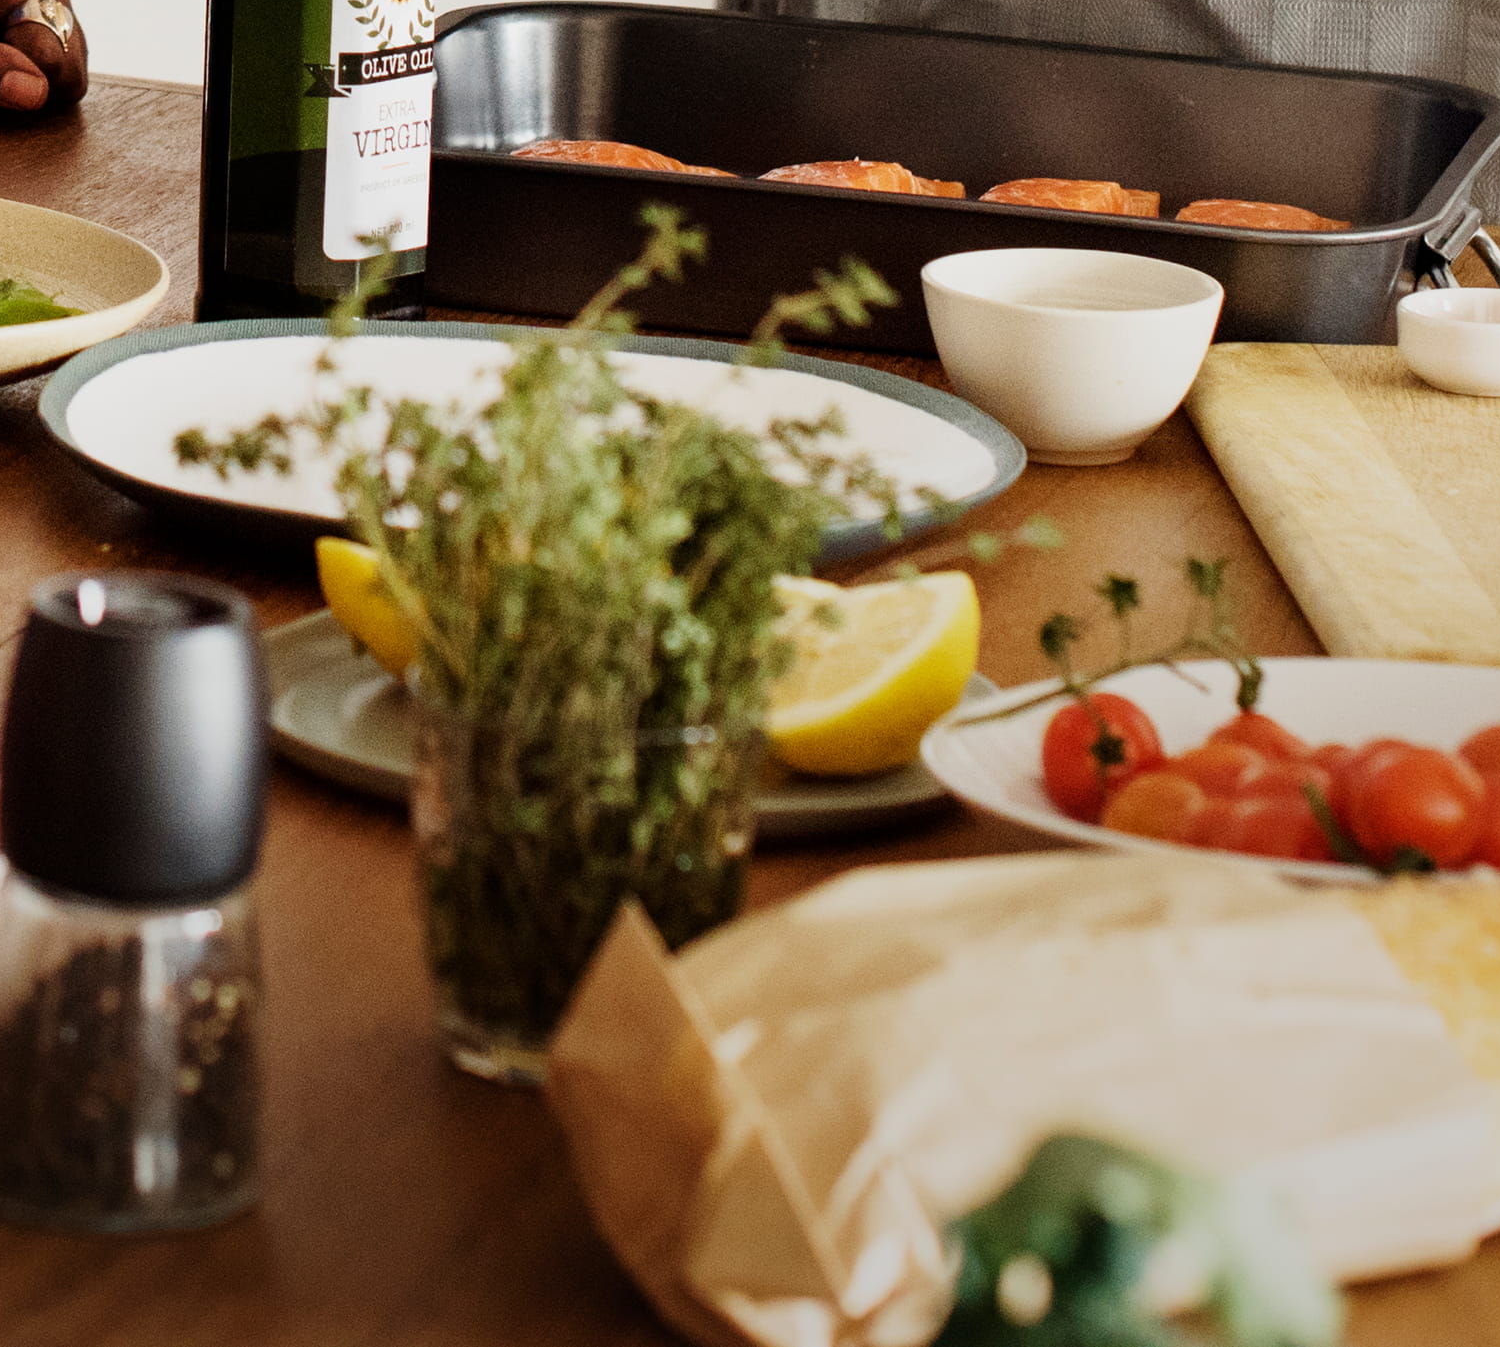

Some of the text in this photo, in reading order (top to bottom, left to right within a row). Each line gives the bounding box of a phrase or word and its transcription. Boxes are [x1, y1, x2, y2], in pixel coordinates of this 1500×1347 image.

[361, 47, 433, 79] OLIVE OIL
[379, 99, 416, 122] EXTRA
